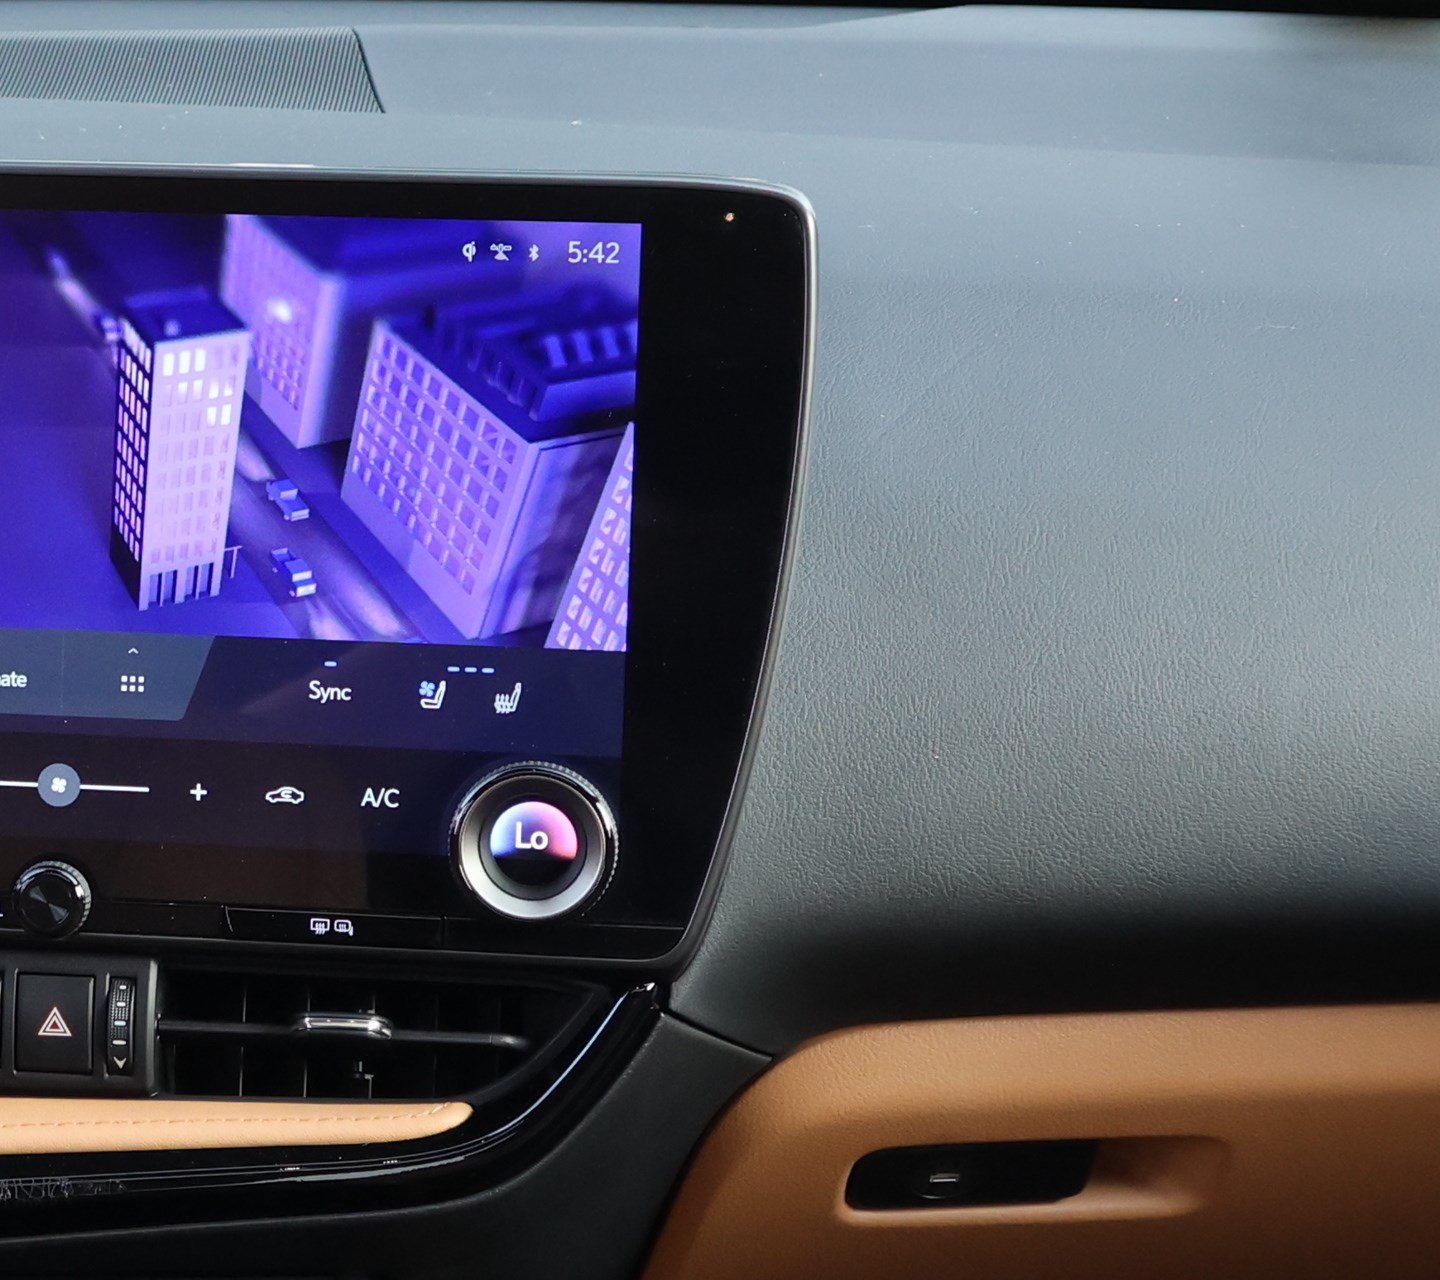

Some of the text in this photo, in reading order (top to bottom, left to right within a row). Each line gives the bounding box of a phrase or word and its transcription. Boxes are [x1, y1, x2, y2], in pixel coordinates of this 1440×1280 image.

[567, 240, 621, 264] 5:42
[308, 680, 352, 703] Sync
[360, 786, 401, 810] A/C
[514, 821, 549, 851] Lo
